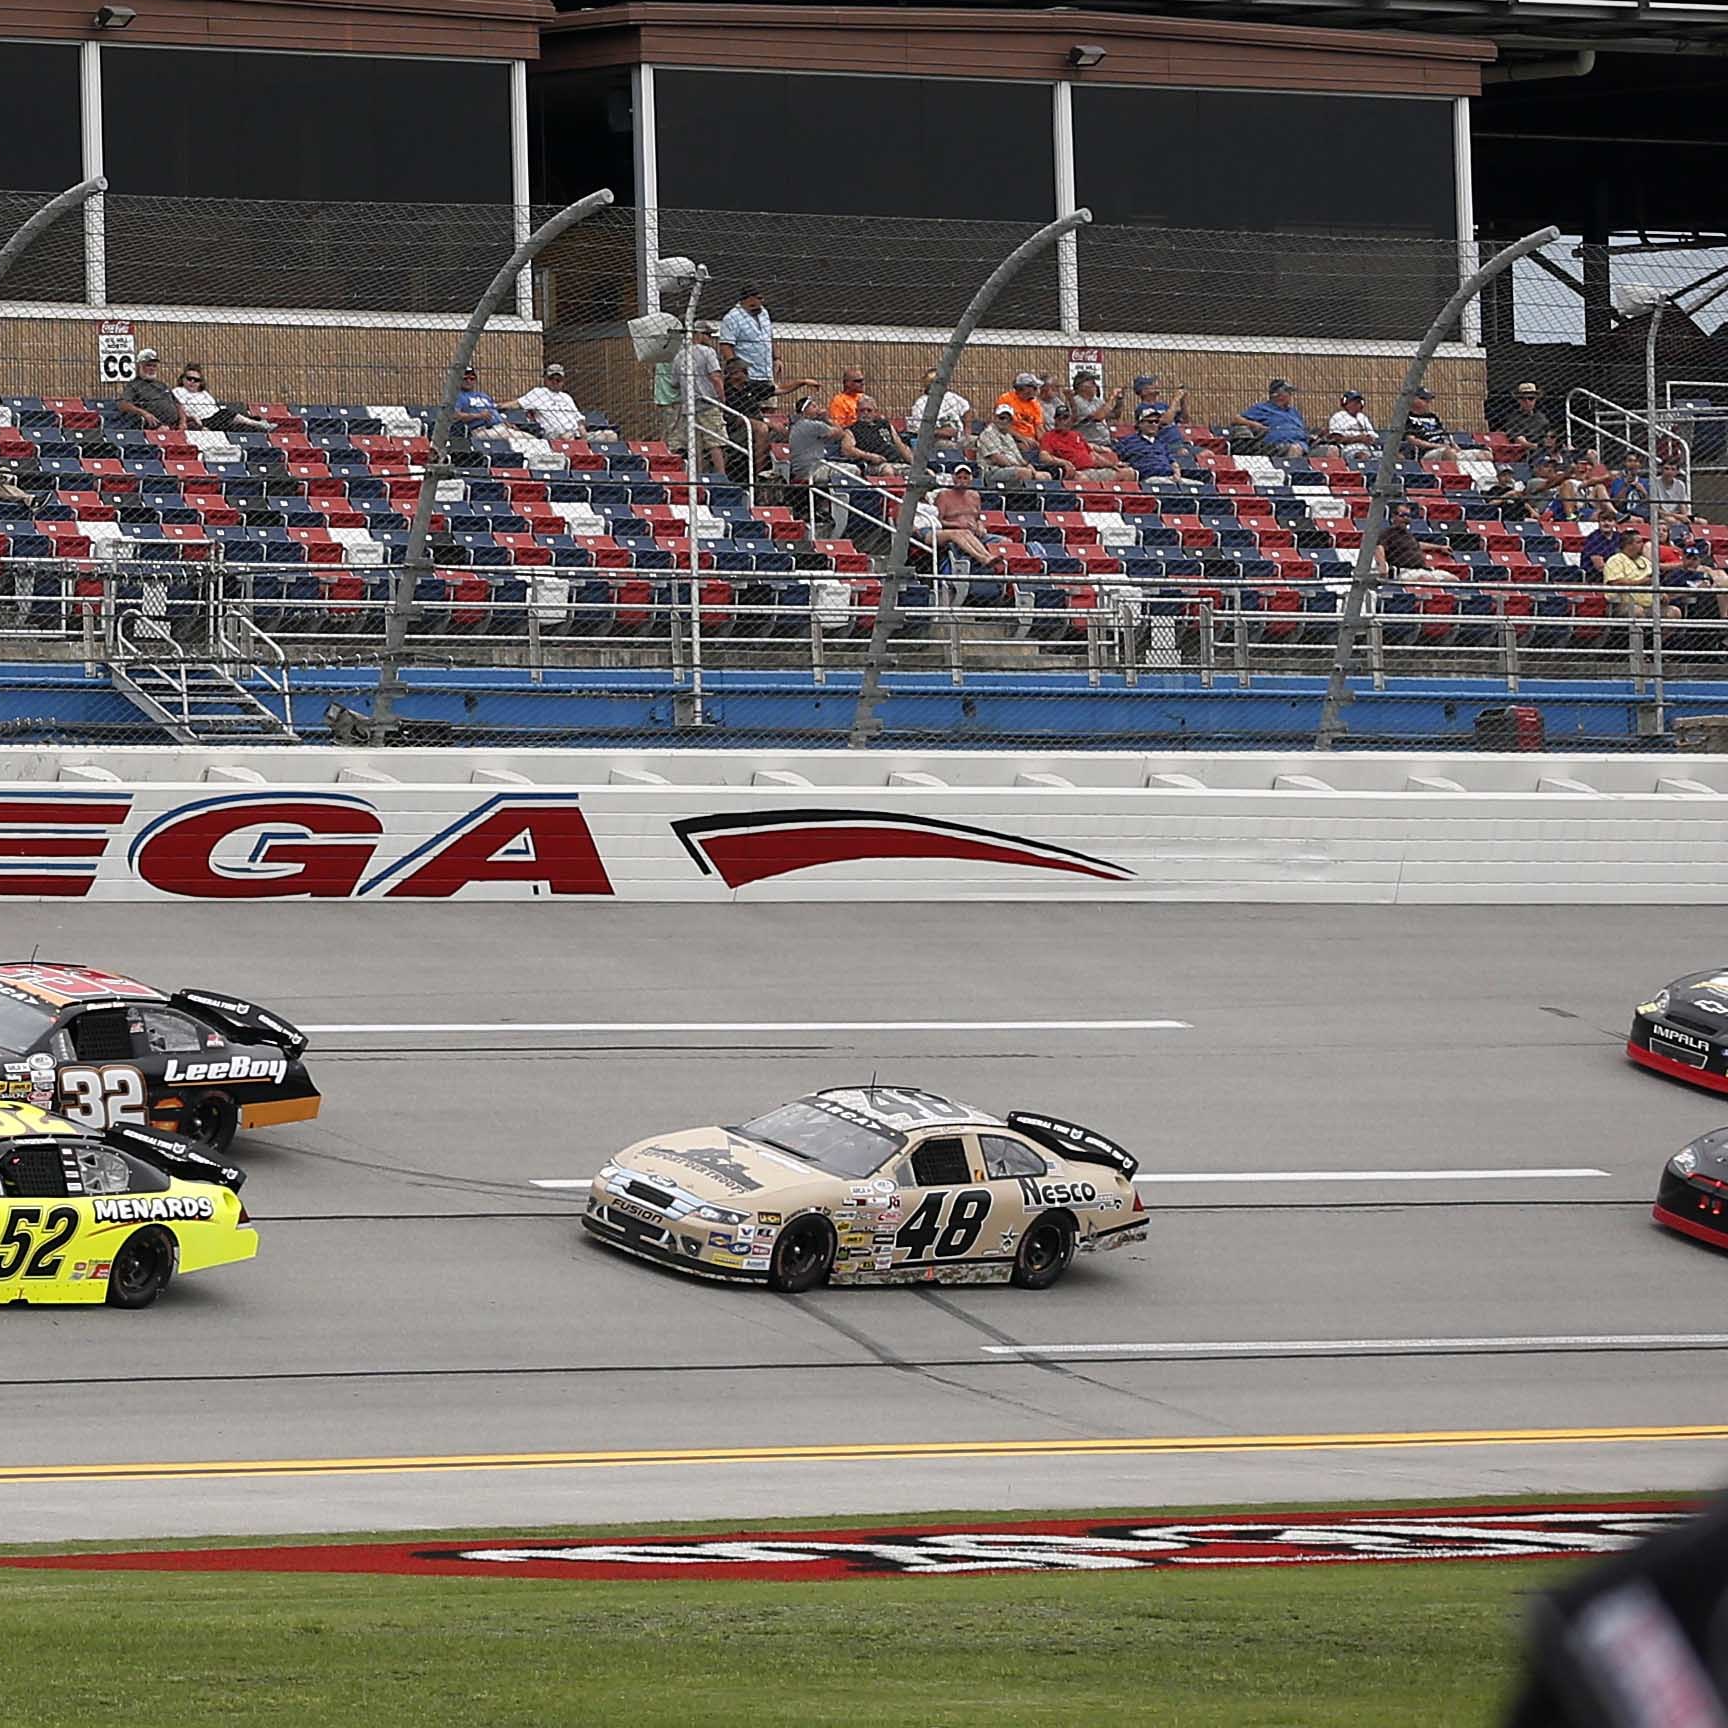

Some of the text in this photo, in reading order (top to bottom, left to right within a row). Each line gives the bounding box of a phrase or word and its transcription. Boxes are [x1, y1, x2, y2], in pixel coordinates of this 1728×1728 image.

[104, 355, 133, 378] CC
[1653, 1023, 1710, 1053] IMPALA
[164, 1055, 288, 1084] LeeBoy
[59, 1065, 149, 1129] 32
[814, 1102, 873, 1129] ARCA
[93, 1196, 215, 1223] MENARDS
[611, 1198, 664, 1224] FUSION
[895, 1188, 994, 1260] 48
